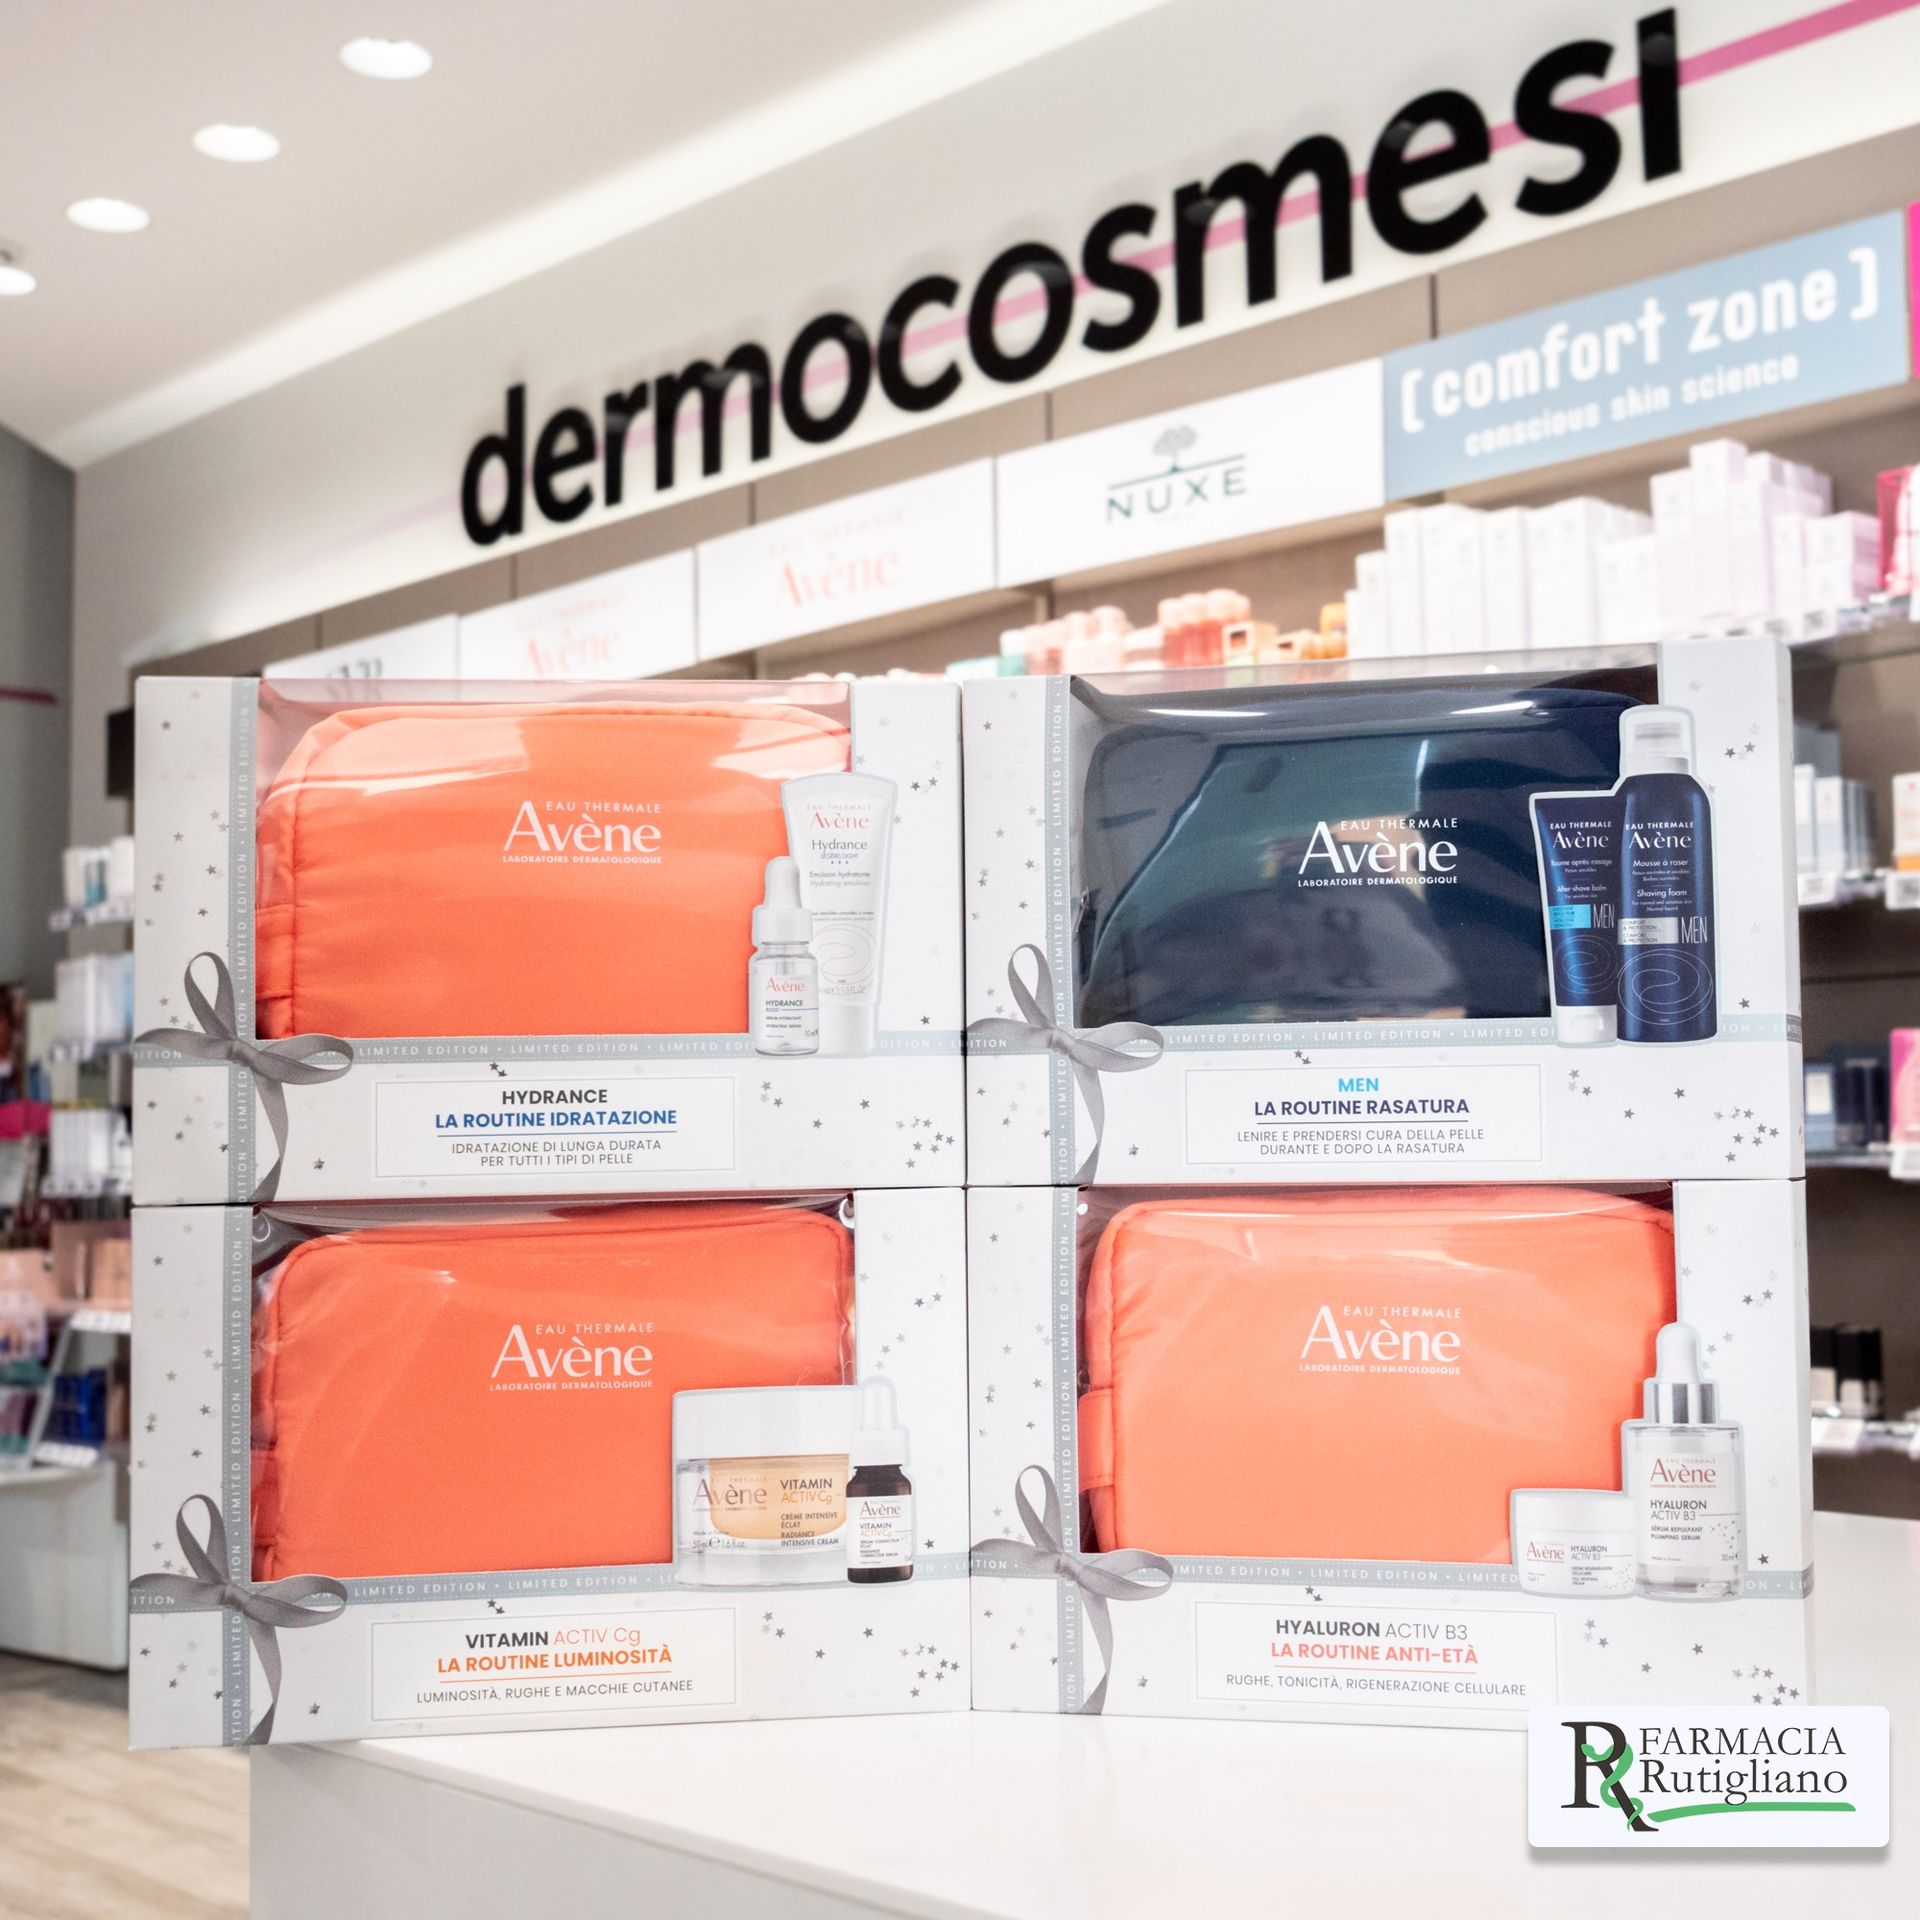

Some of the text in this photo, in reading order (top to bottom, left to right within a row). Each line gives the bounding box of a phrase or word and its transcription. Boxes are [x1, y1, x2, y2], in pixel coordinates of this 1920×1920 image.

[460, 7, 1682, 546] dermocosmesi
[1432, 269, 1837, 416] comfort zone
[1681, 354, 1799, 405] science
[1107, 466, 1246, 523] NUXE
[546, 801, 661, 813] EAU THERMALE
[503, 800, 662, 853] Avène
[810, 811, 869, 829] Avène
[1340, 818, 1458, 830] EAU THERMALE
[1550, 821, 1612, 830] EAU THERMALE
[1647, 821, 1694, 829] THERMALE
[812, 838, 868, 855] Hydrance
[1553, 831, 1609, 849] Avène
[1629, 831, 1692, 849] Avène
[1298, 821, 1458, 875] Avène
[502, 855, 662, 864] LABORATOIRE DERMATOLOGIQUE
[1298, 876, 1458, 888] LABORATOIRE DERMATOLOGIQUE
[1637, 889, 1666, 899] Shaving
[1053, 847, 1064, 971] LIMITED EDITION
[1593, 903, 1614, 929] MEN
[1681, 916, 1708, 944] MEN
[766, 977, 805, 992] Avène
[1169, 1033, 1225, 1044] LIMITED
[1233, 1032, 1292, 1042] EDITION
[1381, 1029, 1440, 1040] EDITION
[358, 1046, 419, 1056] LIMITED
[427, 1044, 488, 1055] EDITION
[1338, 1077, 1379, 1092] MEN
[501, 1089, 608, 1105] HYDRANCE
[1254, 1099, 1470, 1116] LA ROUTINE RASATURA
[435, 1109, 676, 1128] LA ROUTINE IDRATAZIONE
[1237, 1128, 1484, 1142] LENIRE E PRENDERSI CURA DELLA PELLE
[452, 1139, 661, 1154] IDRATAZIONE DI LUNGA DURATA
[1260, 1142, 1465, 1155] DURANTE E DOPO LA RASATURA
[481, 1156, 503, 1167] PER
[509, 1155, 543, 1166] TUTTI
[554, 1154, 577, 1165] TIPI
[582, 1153, 595, 1164] DI
[599, 1153, 633, 1164] PELLE
[1343, 1305, 1461, 1318] EAU THERMALE
[536, 1322, 654, 1335] EAU THERMALE
[1300, 1305, 1461, 1362] Avène
[491, 1324, 653, 1378] Avène
[1299, 1363, 1460, 1375] LABORATOIRE DERMATOLOGIQUE
[232, 1241, 242, 1523] LIMITED EDITION LIMITED EDITION
[490, 1380, 652, 1392] LABORATOIRE DERMATOLOGIQUE
[1650, 1458, 1716, 1483] Avène
[693, 1478, 767, 1505] Avène
[780, 1478, 832, 1490] VITAMIN
[860, 1501, 901, 1516] Avène
[1650, 1500, 1707, 1509] HYALURON
[781, 1511, 838, 1521] CRÈME INTENSIVE
[1650, 1510, 1696, 1521] ACTIV B3
[780, 1537, 839, 1547] INTENSIVE CREAM
[781, 1530, 815, 1539] RADIANCE
[1527, 1541, 1564, 1559] Avène
[1231, 1566, 1368, 1579] EDITION LIMITED
[354, 1582, 486, 1596] LIMITED EDITION
[1276, 1619, 1468, 1641] HYALURON ACTIV B3
[465, 1627, 641, 1649] VITAMIN ACTIV Cg
[437, 1643, 672, 1673] LA ROUTINE LUMINOSITÀ
[1271, 1642, 1478, 1664] LA ROUTINE ANTI-ETÀ
[1226, 1672, 1527, 1696] RUGHE, TONICITÀ, RIGENERAZIONE CELLULARE
[416, 1680, 693, 1704] LUMINOSITÀ, RUGHE E MACCHIE CUTANEE
